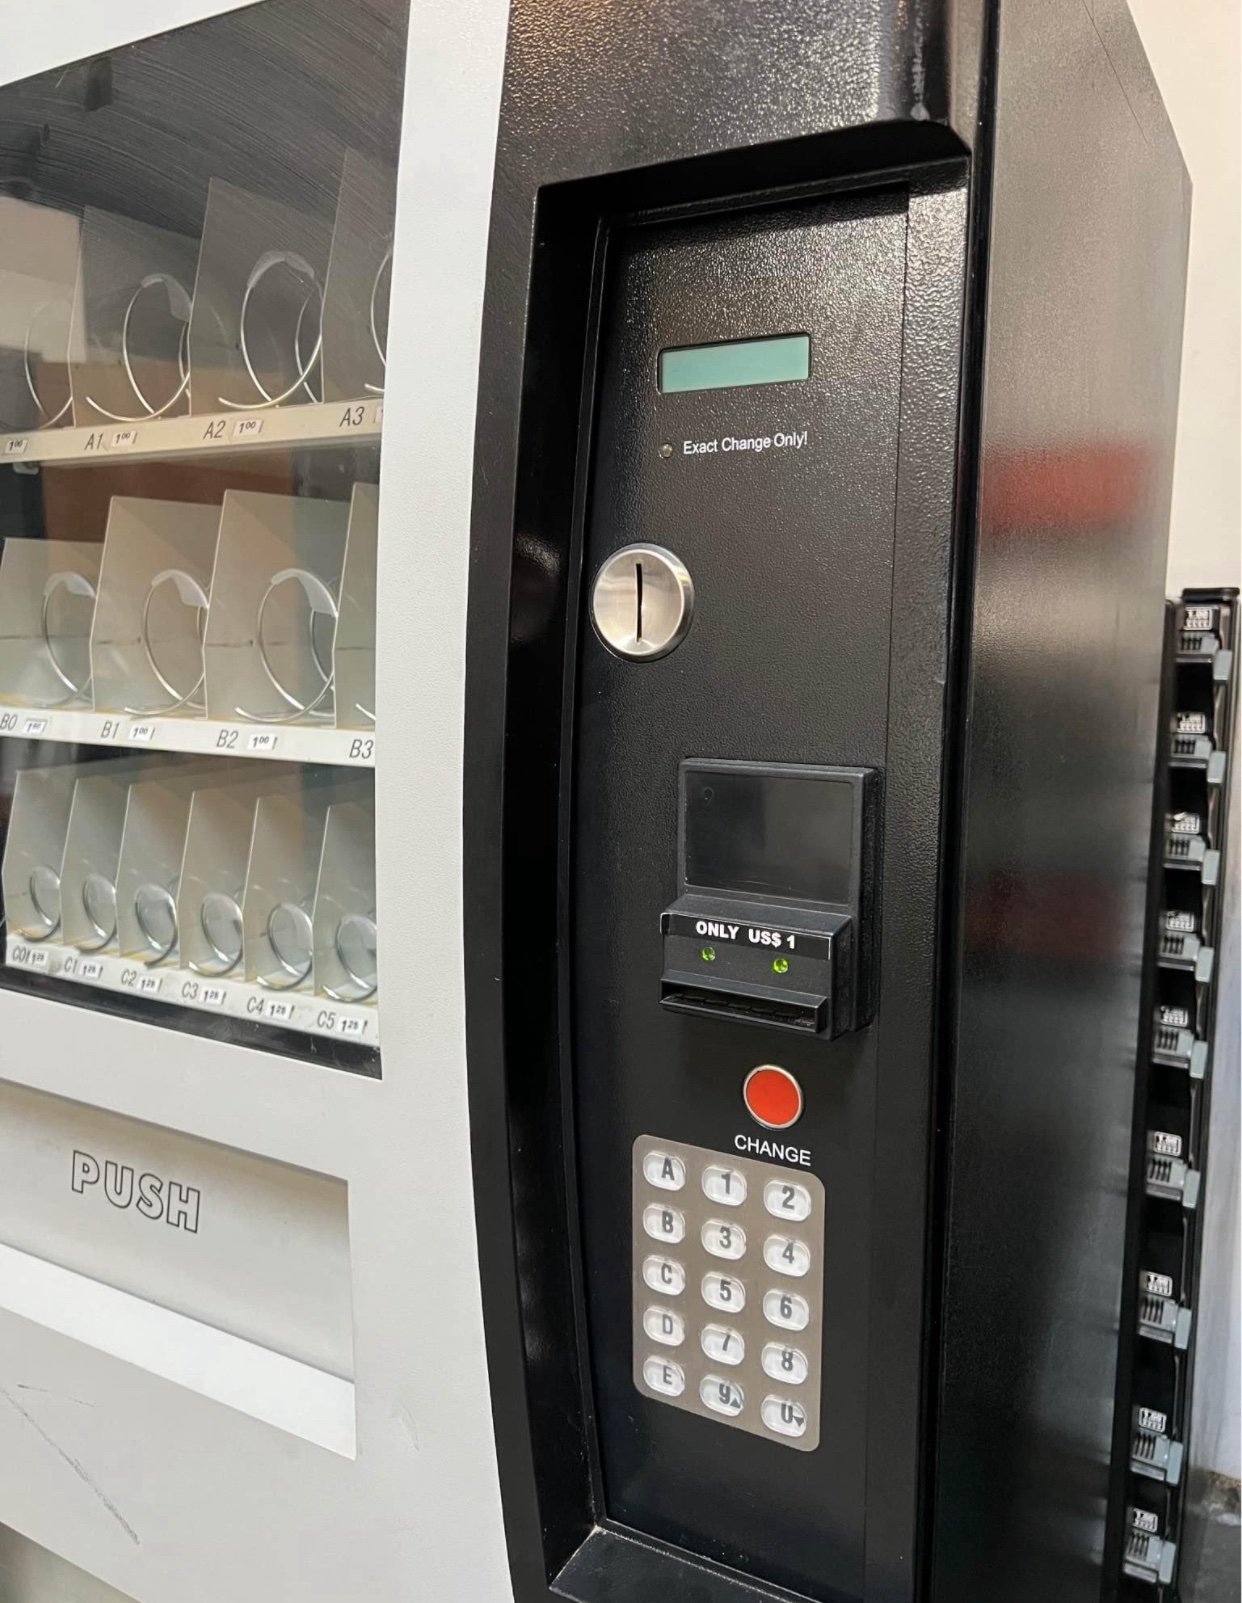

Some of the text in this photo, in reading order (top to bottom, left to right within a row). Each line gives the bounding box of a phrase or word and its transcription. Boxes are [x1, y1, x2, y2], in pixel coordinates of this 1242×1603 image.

[340, 406, 365, 427] A3
[203, 420, 226, 439] A2
[84, 433, 103, 450] A1
[683, 431, 808, 454] Exact Change Only!
[101, 720, 120, 739] B1
[216, 729, 239, 749] B2
[349, 739, 374, 759] B3
[695, 920, 796, 949] ONLY US$ 1
[64, 956, 78, 975] C1
[121, 968, 137, 986] C2
[182, 981, 199, 999] C3
[246, 996, 265, 1015] C4
[317, 1010, 336, 1030] C5
[734, 1134, 812, 1167] CHANGE
[661, 1157, 675, 1181] A
[71, 1150, 201, 1234] PUSH
[721, 1173, 731, 1195] 1
[781, 1185, 795, 1210] 2
[662, 1211, 674, 1234] B
[719, 1226, 732, 1249] 3
[782, 1242, 795, 1264] 4
[661, 1263, 672, 1284] C
[719, 1279, 732, 1301] 5
[780, 1295, 793, 1319] 6
[662, 1314, 673, 1335] D
[781, 1350, 793, 1372] 8
[662, 1365, 673, 1385] E
